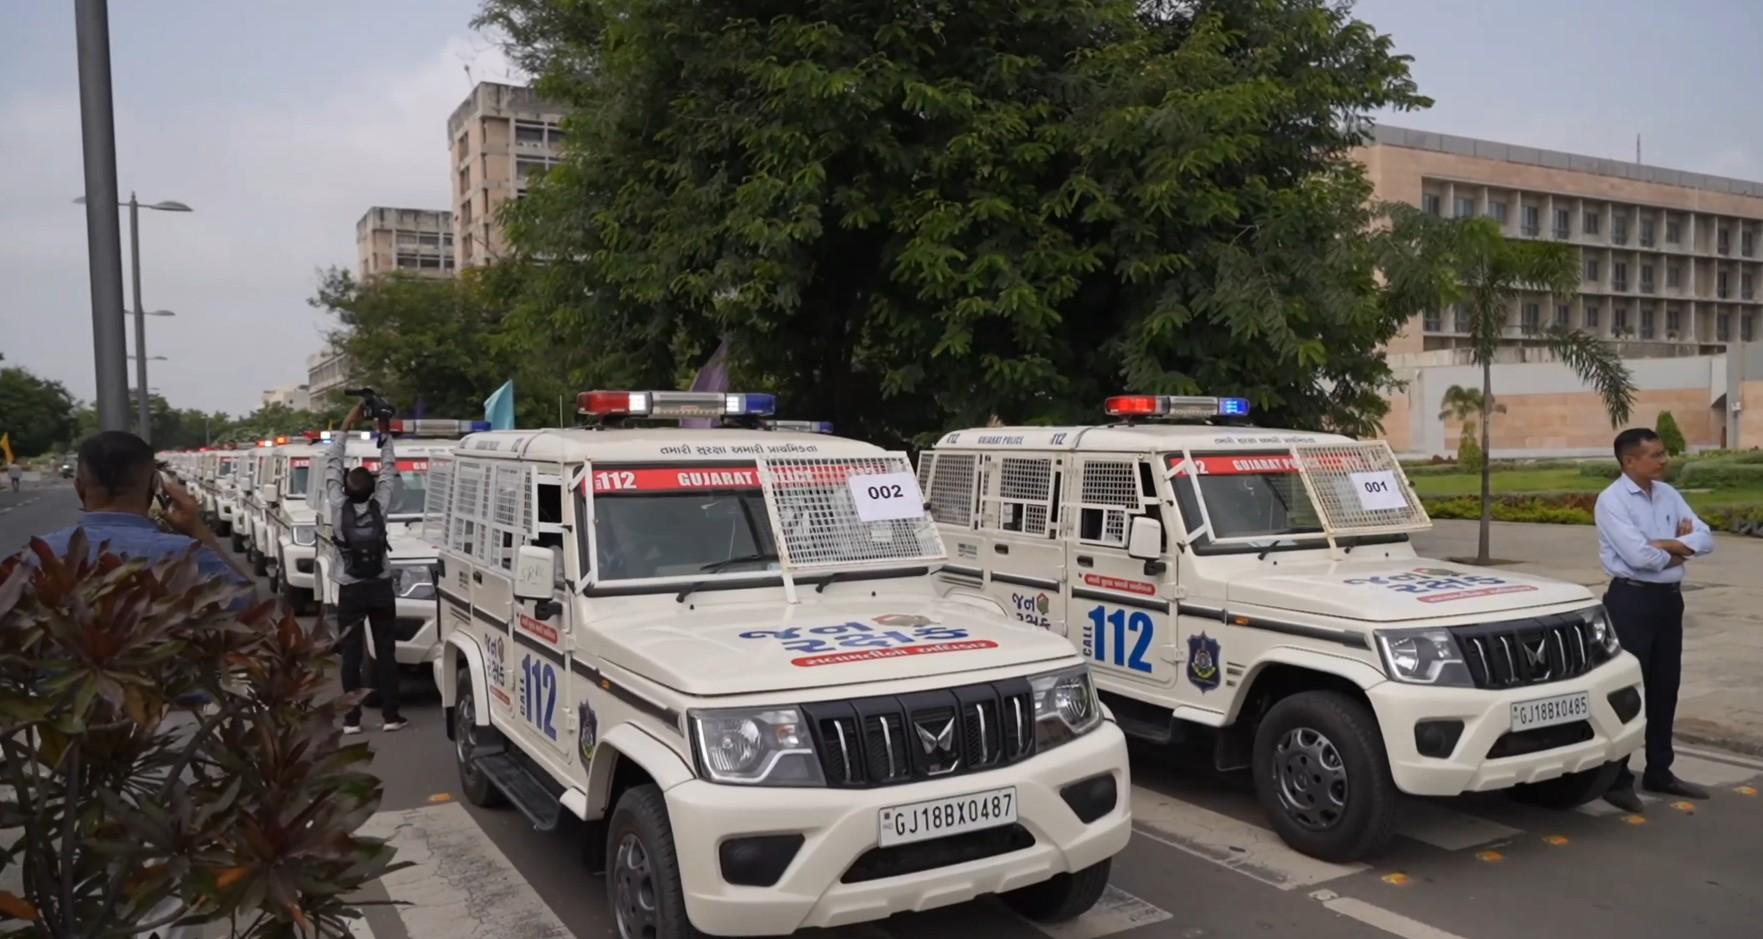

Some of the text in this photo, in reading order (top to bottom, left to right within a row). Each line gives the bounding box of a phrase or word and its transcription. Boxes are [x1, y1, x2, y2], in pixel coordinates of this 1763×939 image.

[1050, 433, 1067, 445] 112
[1232, 458, 1282, 471] GUJARAT
[596, 471, 637, 490] 112
[677, 471, 753, 486] GUJARAT
[1364, 481, 1388, 494] 001
[867, 484, 904, 500] 002
[1012, 592, 1035, 612] જન
[739, 622, 873, 640] જન
[1083, 605, 1154, 673] CALL 112
[522, 653, 557, 741] 112
[895, 793, 1012, 836] GJ18BX0487
